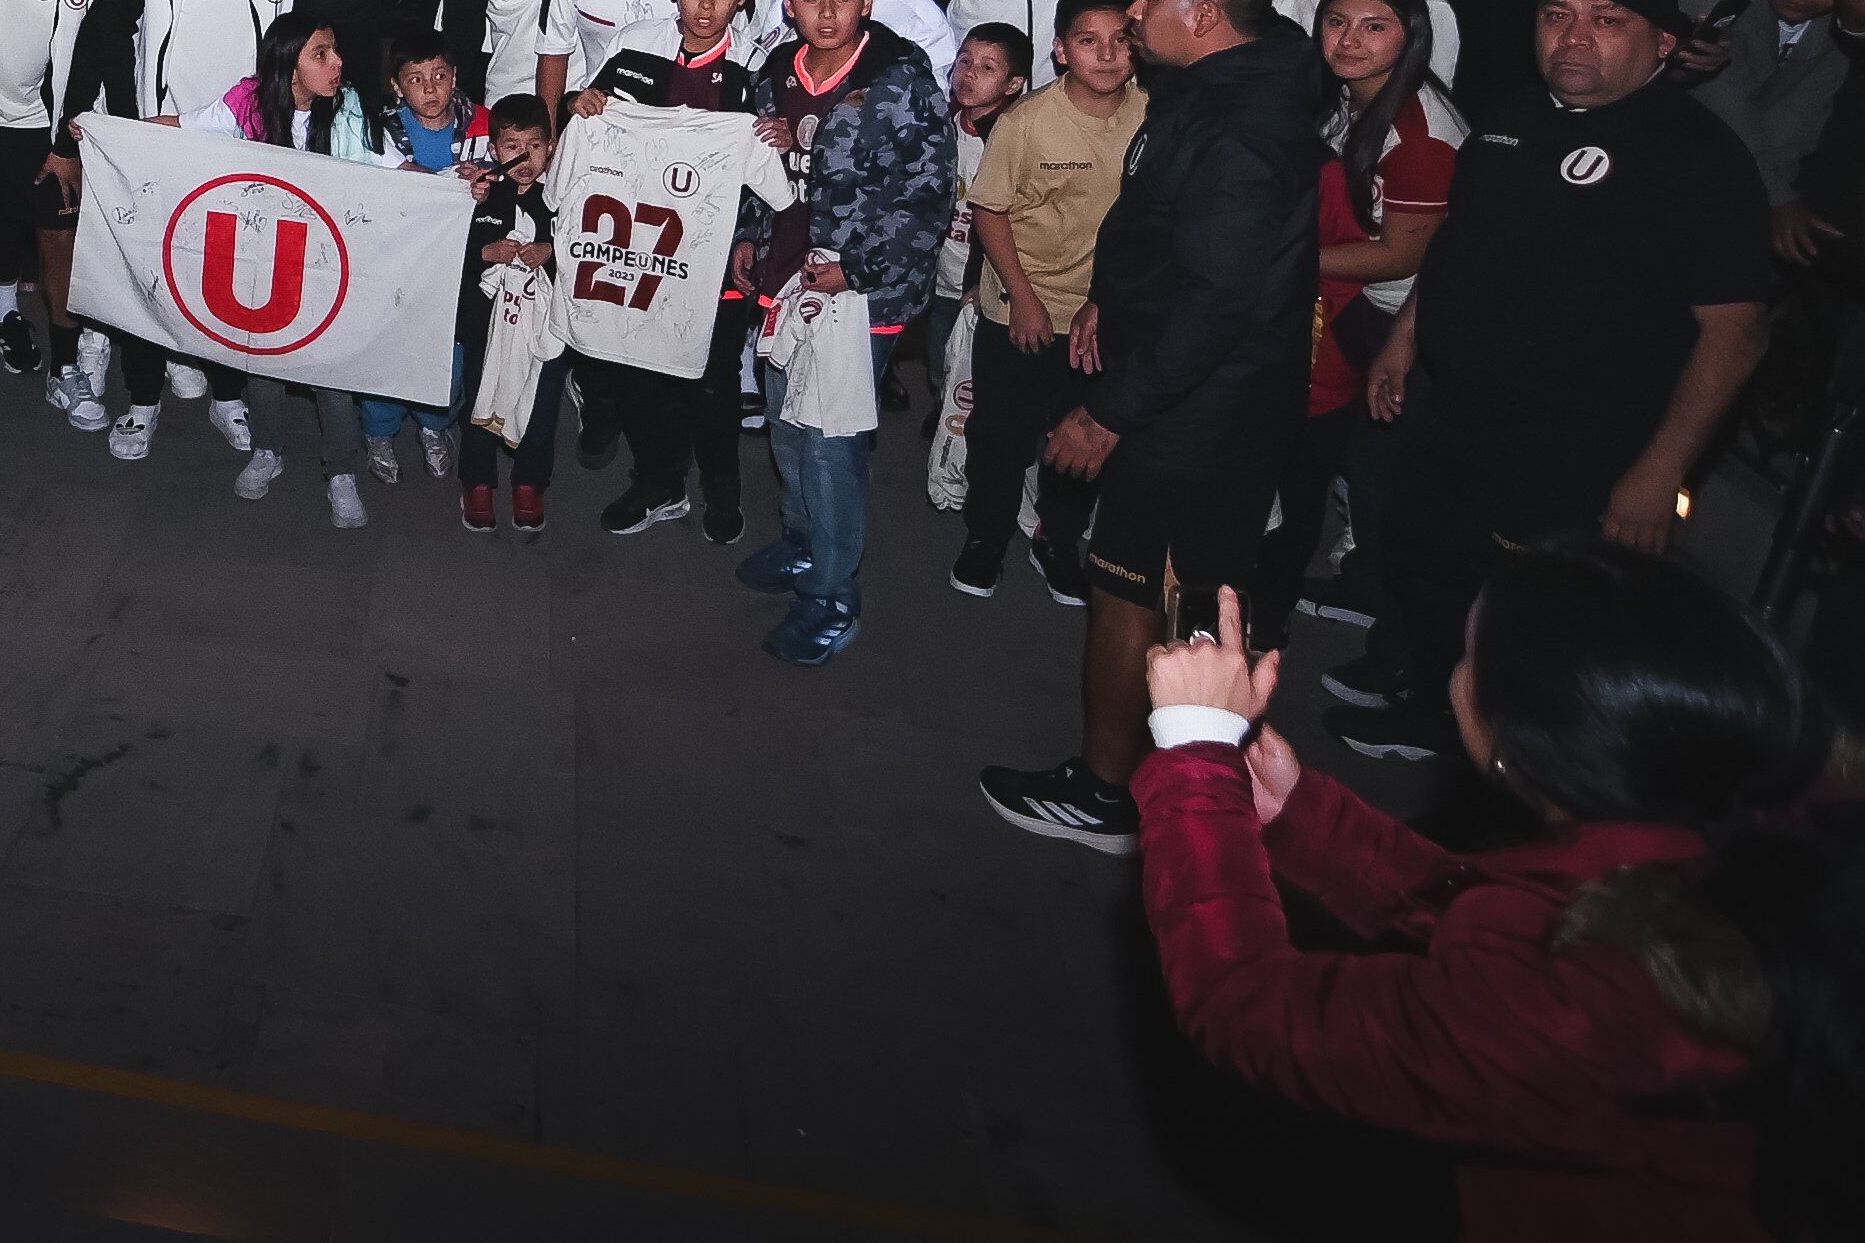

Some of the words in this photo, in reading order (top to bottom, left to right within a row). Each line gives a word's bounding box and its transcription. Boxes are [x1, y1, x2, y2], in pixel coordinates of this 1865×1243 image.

[201, 210, 309, 334] U
[573, 193, 684, 312] 27
[608, 268, 635, 282] 2023
[1088, 552, 1146, 585] marathon
